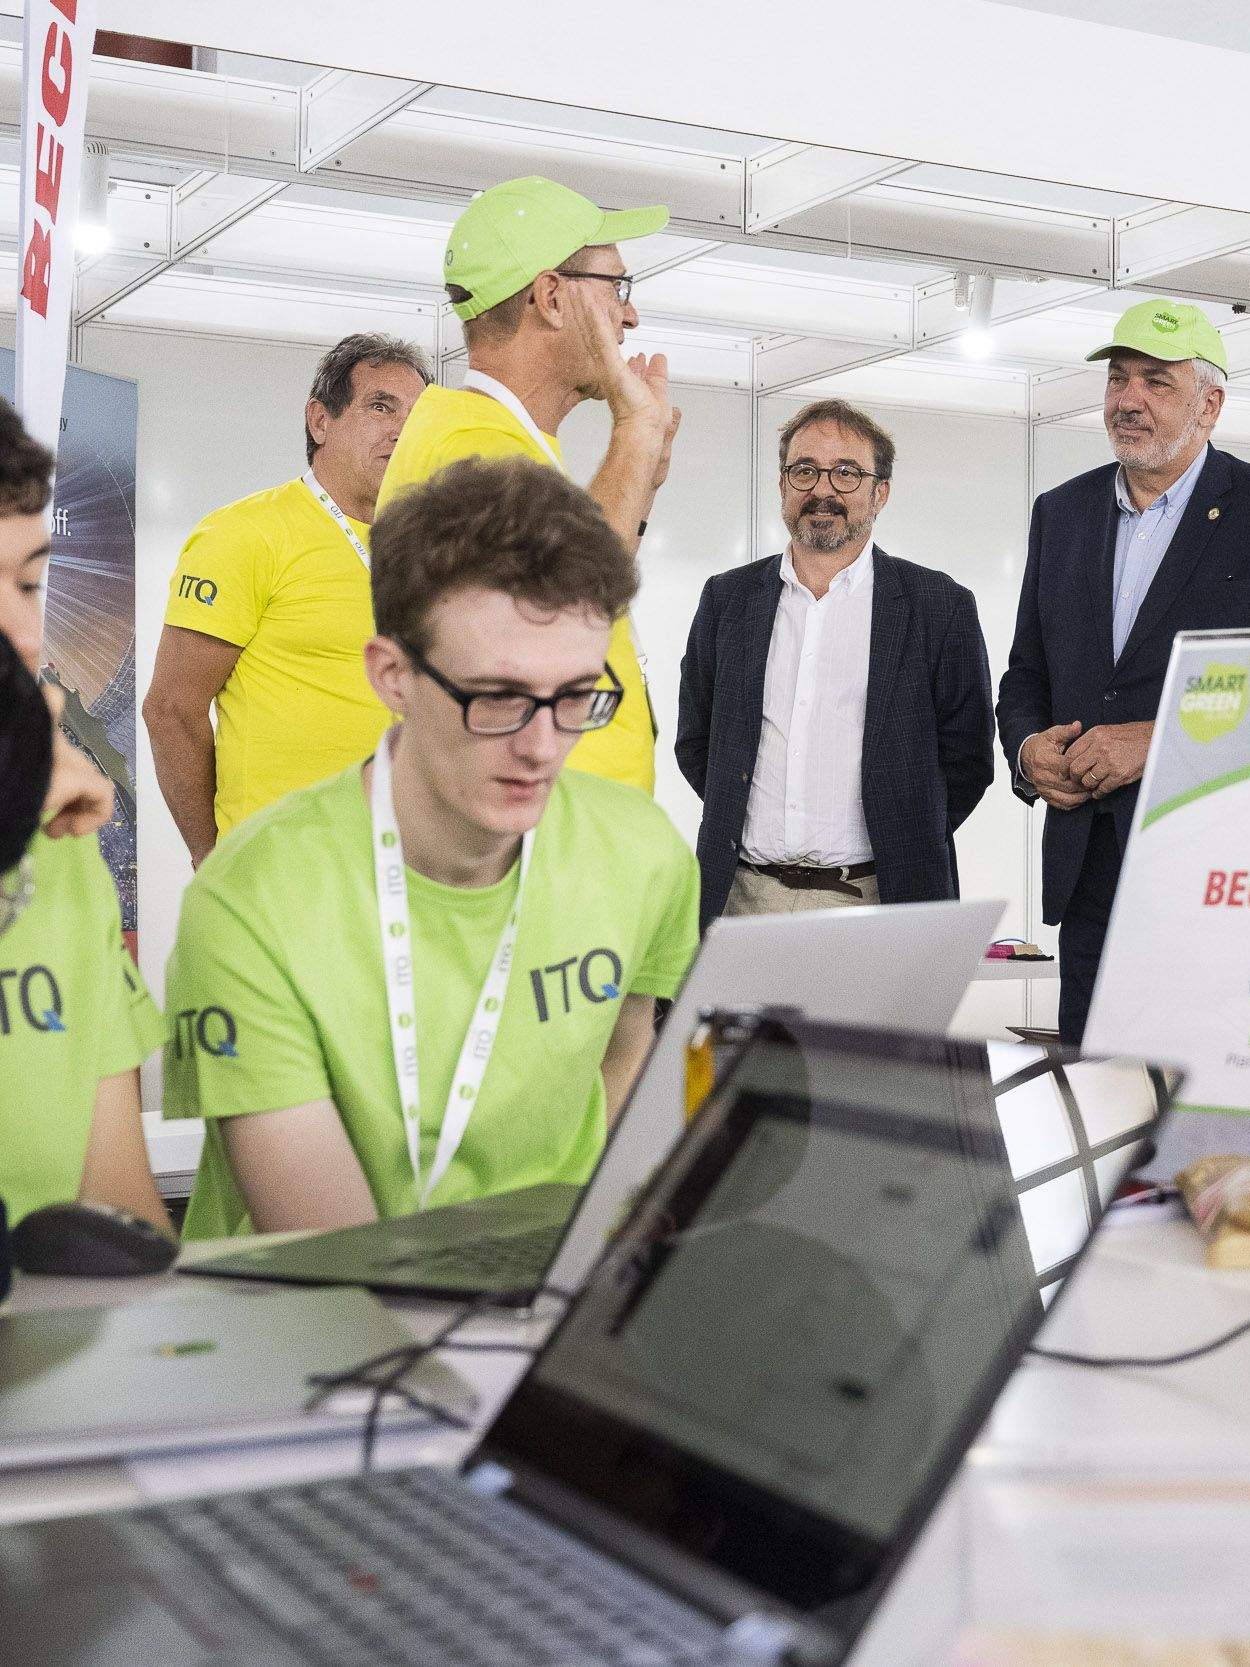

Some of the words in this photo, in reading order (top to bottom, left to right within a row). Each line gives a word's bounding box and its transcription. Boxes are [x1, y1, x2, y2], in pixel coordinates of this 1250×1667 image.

[1153, 312, 1179, 325] SMART
[178, 574, 218, 607] ITQ
[1184, 673, 1247, 693] SMART
[1180, 691, 1241, 712] GREEN
[530, 948, 622, 1022] ITQ
[174, 1004, 238, 1060] ITQ
